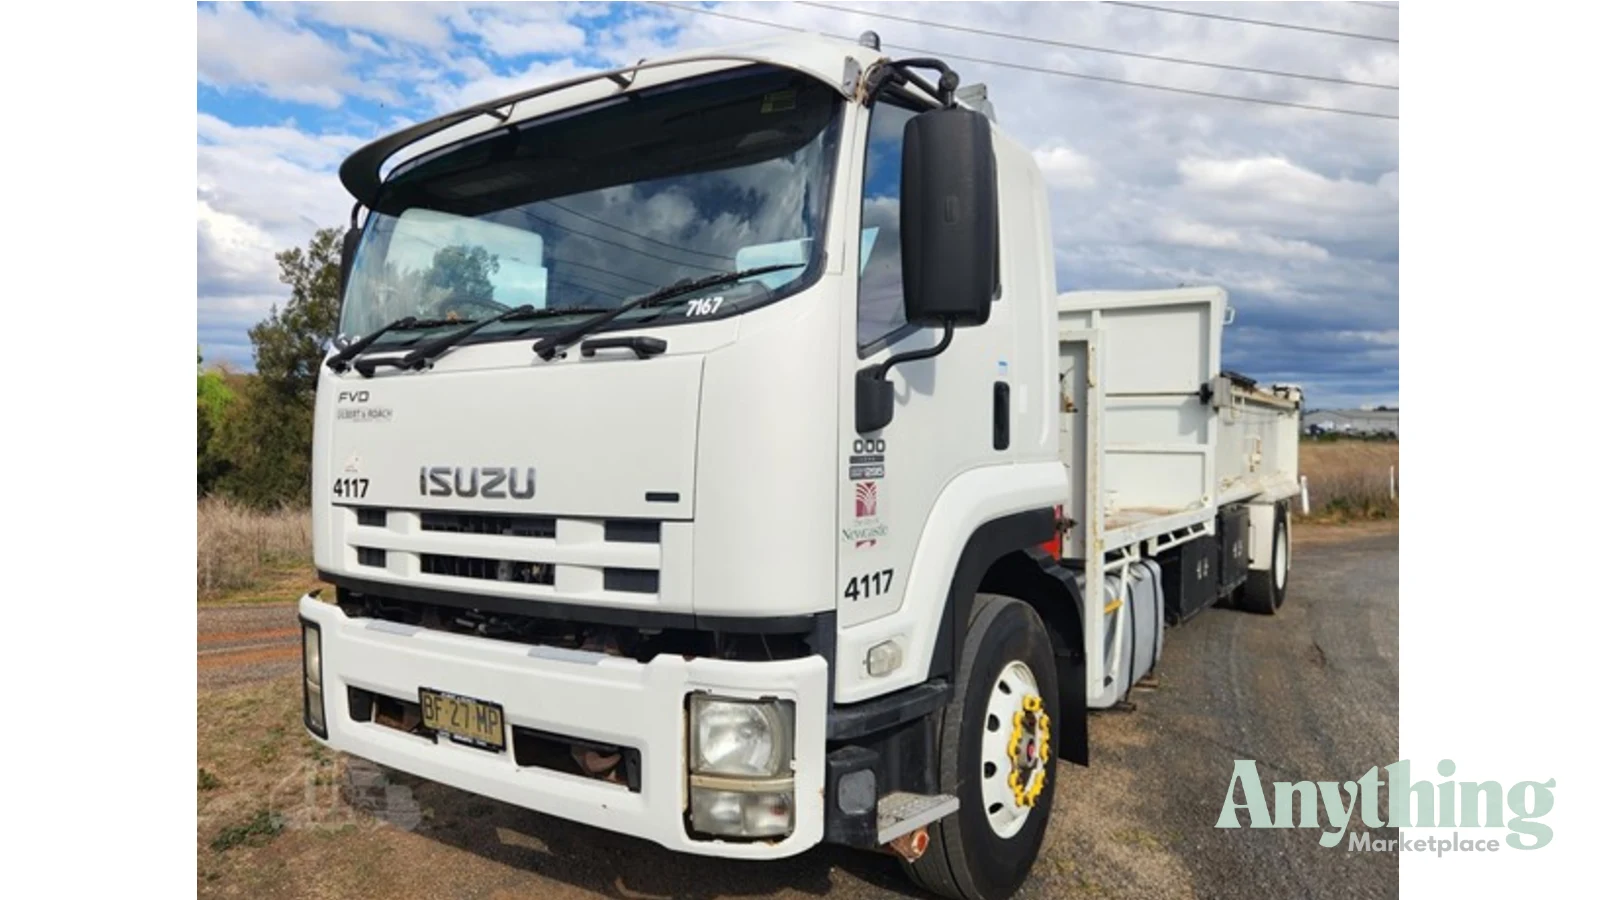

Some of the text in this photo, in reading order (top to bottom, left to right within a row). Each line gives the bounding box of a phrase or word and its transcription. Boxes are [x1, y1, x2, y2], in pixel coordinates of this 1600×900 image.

[686, 296, 724, 317] 7167
[337, 390, 370, 404] FVD
[333, 477, 370, 498] 4117
[419, 465, 536, 500] ISUZU
[844, 568, 894, 601] 4117
